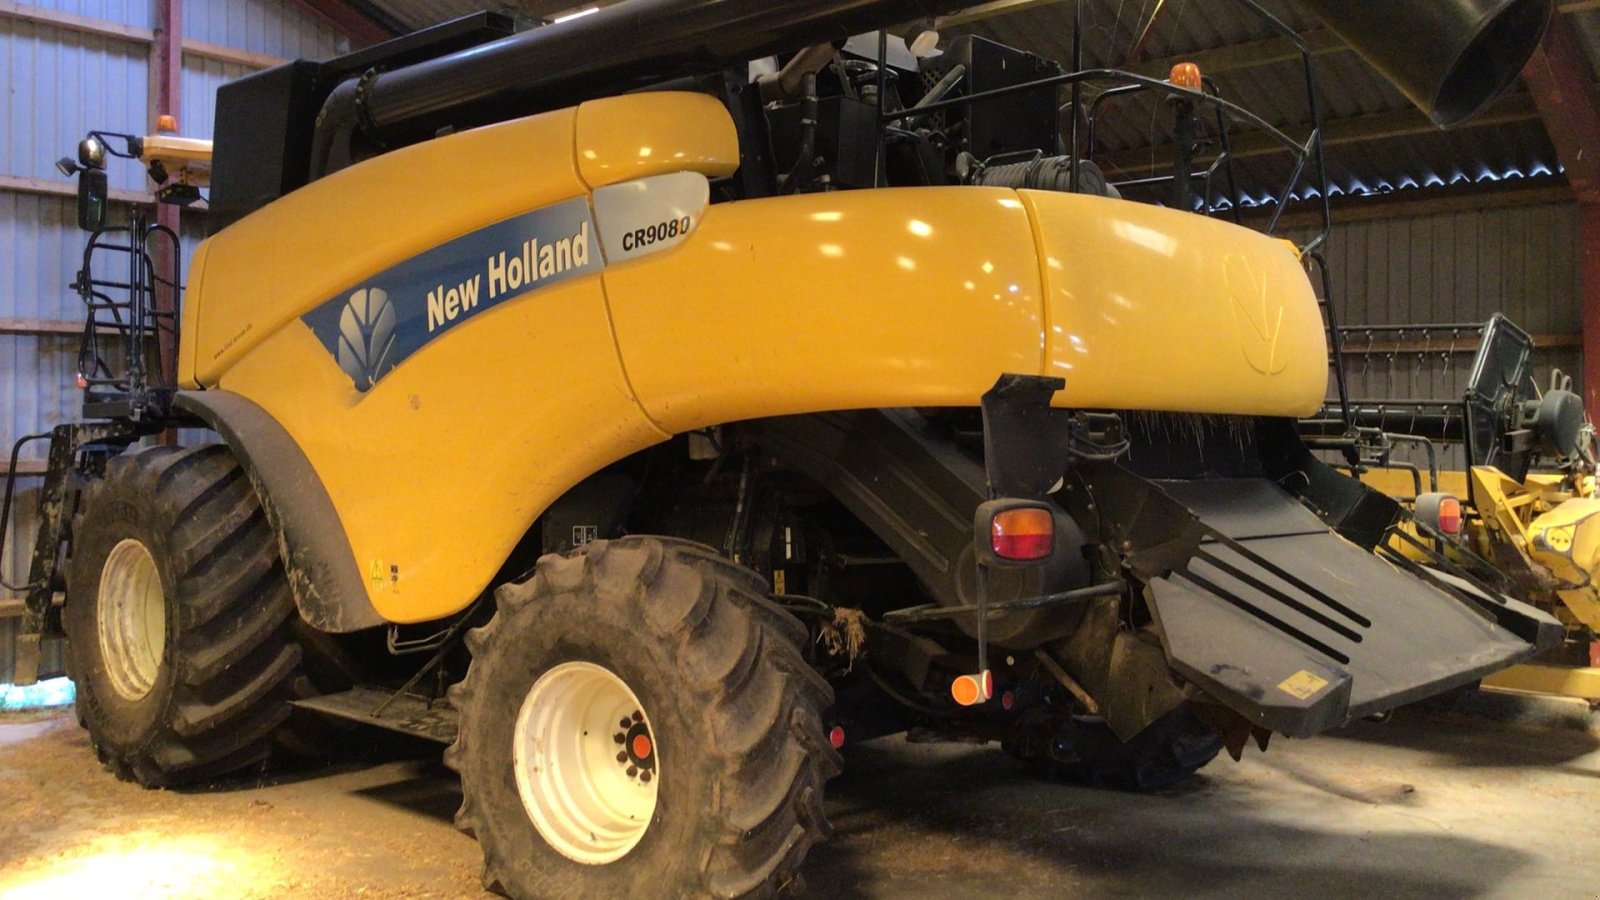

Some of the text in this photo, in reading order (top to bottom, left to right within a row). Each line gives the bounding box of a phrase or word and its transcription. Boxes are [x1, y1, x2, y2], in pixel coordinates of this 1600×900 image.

[622, 215, 691, 252] CR9080
[426, 221, 588, 333] New Holland
